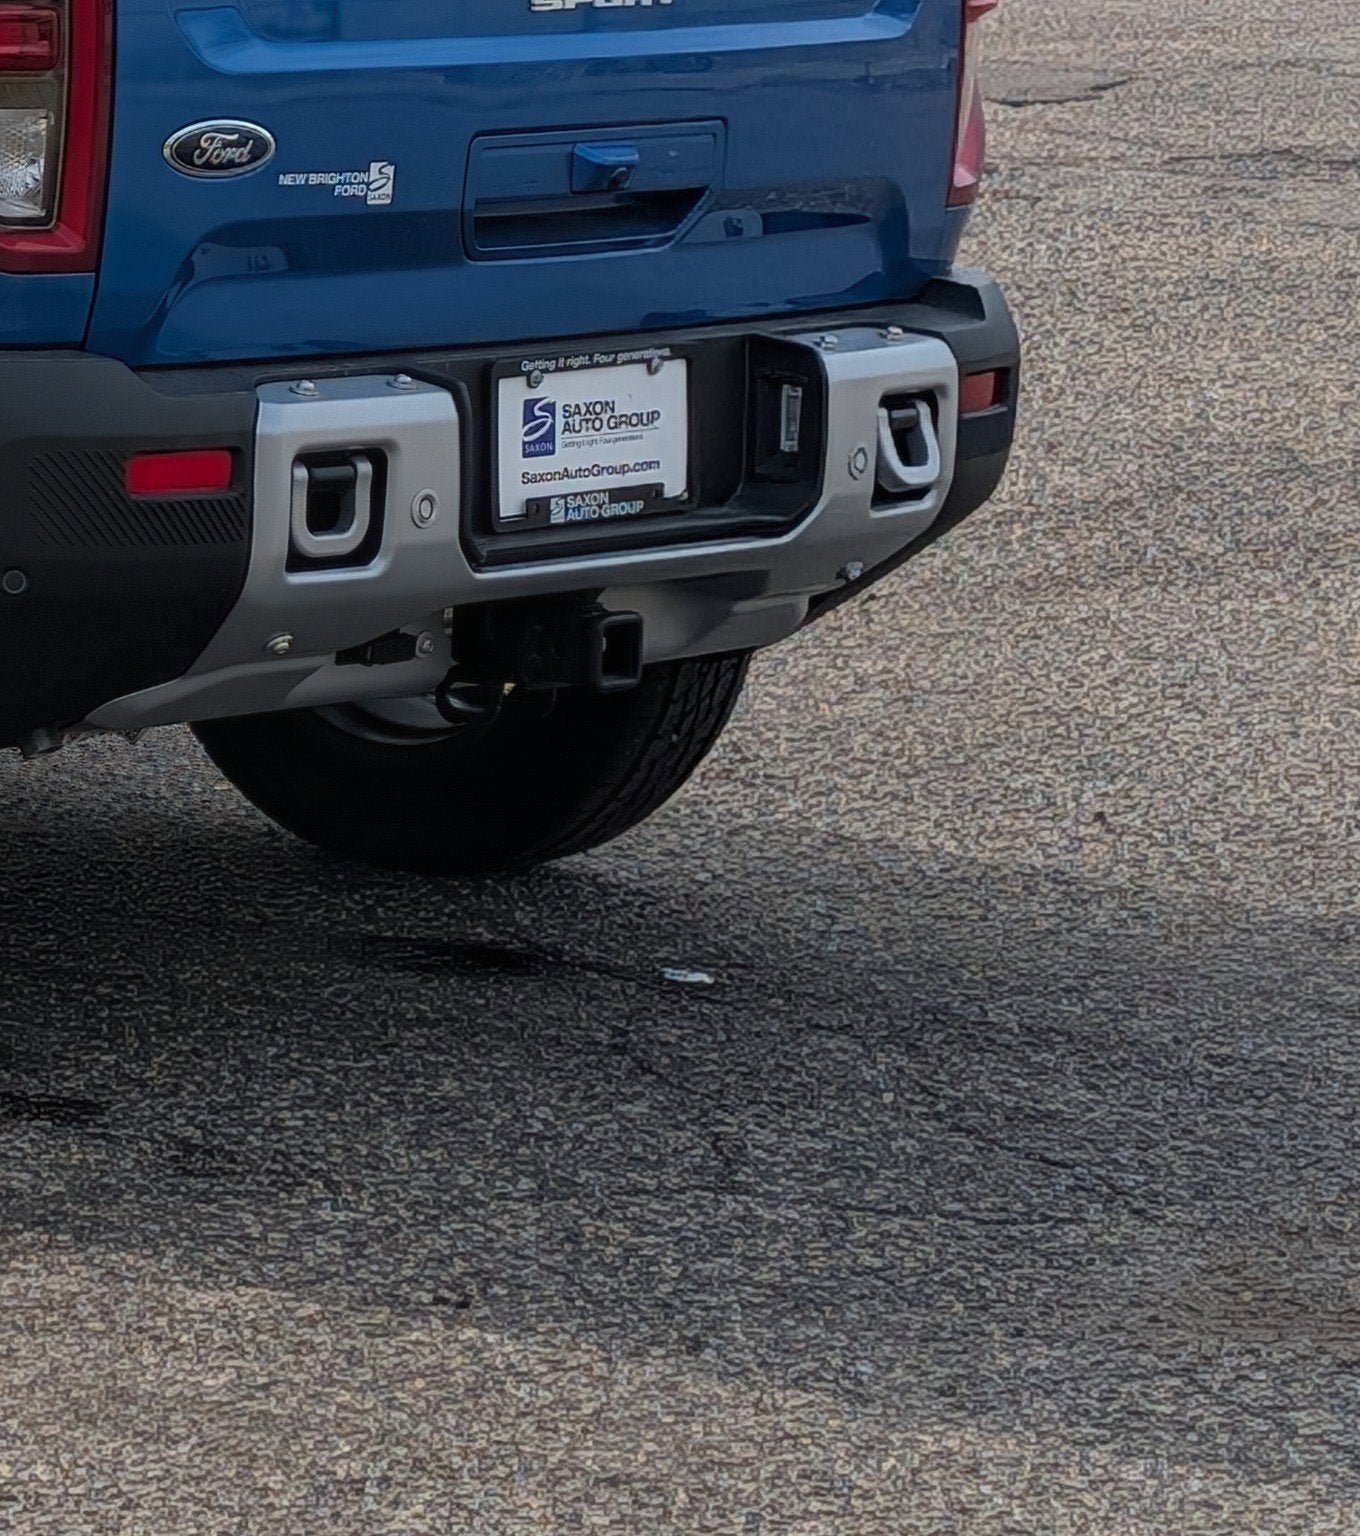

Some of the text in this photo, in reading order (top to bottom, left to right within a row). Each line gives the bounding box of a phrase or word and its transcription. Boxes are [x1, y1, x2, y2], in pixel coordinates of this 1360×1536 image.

[193, 132, 254, 165] Ford
[278, 172, 369, 185] NEW BRIGHTON
[334, 184, 367, 197] FORD
[521, 359, 556, 372] Getting
[558, 357, 565, 368] it
[566, 355, 591, 368] right.
[593, 353, 616, 364] Four
[562, 400, 615, 419] SAXON
[561, 410, 661, 435] AUTO GROUP
[524, 441, 553, 454] SAXON
[521, 460, 660, 484] SaxonAutoGroup.com
[566, 491, 609, 508] SAXON
[566, 500, 644, 521] AUTO GROUP
